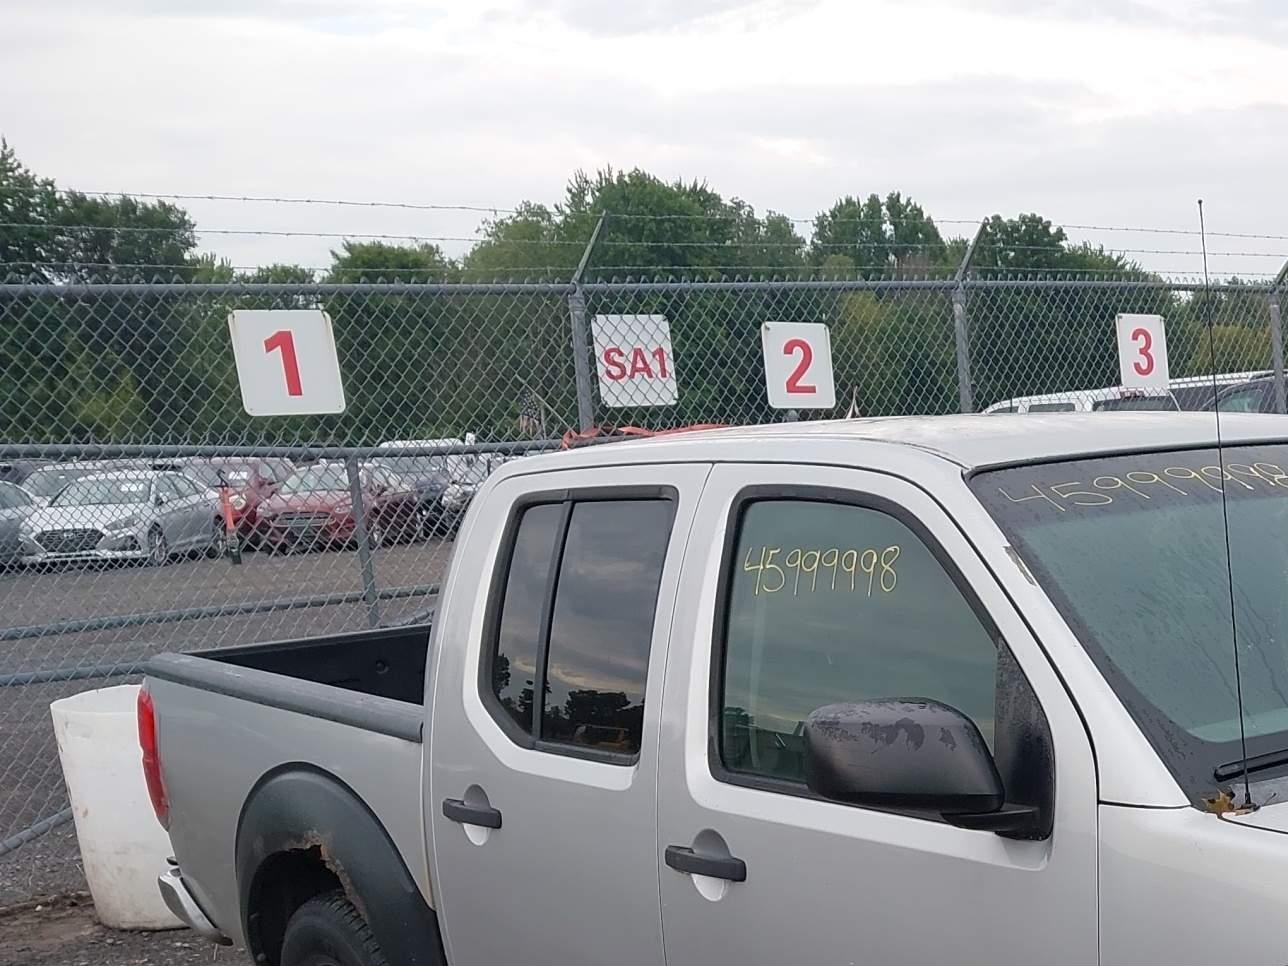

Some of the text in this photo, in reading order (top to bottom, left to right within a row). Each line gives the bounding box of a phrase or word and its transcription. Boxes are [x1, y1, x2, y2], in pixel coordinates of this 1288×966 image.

[263, 330, 303, 396] 1
[603, 346, 668, 381] SA1
[782, 338, 817, 394] 2
[1131, 327, 1154, 376] 3
[743, 545, 900, 598] 45999998
